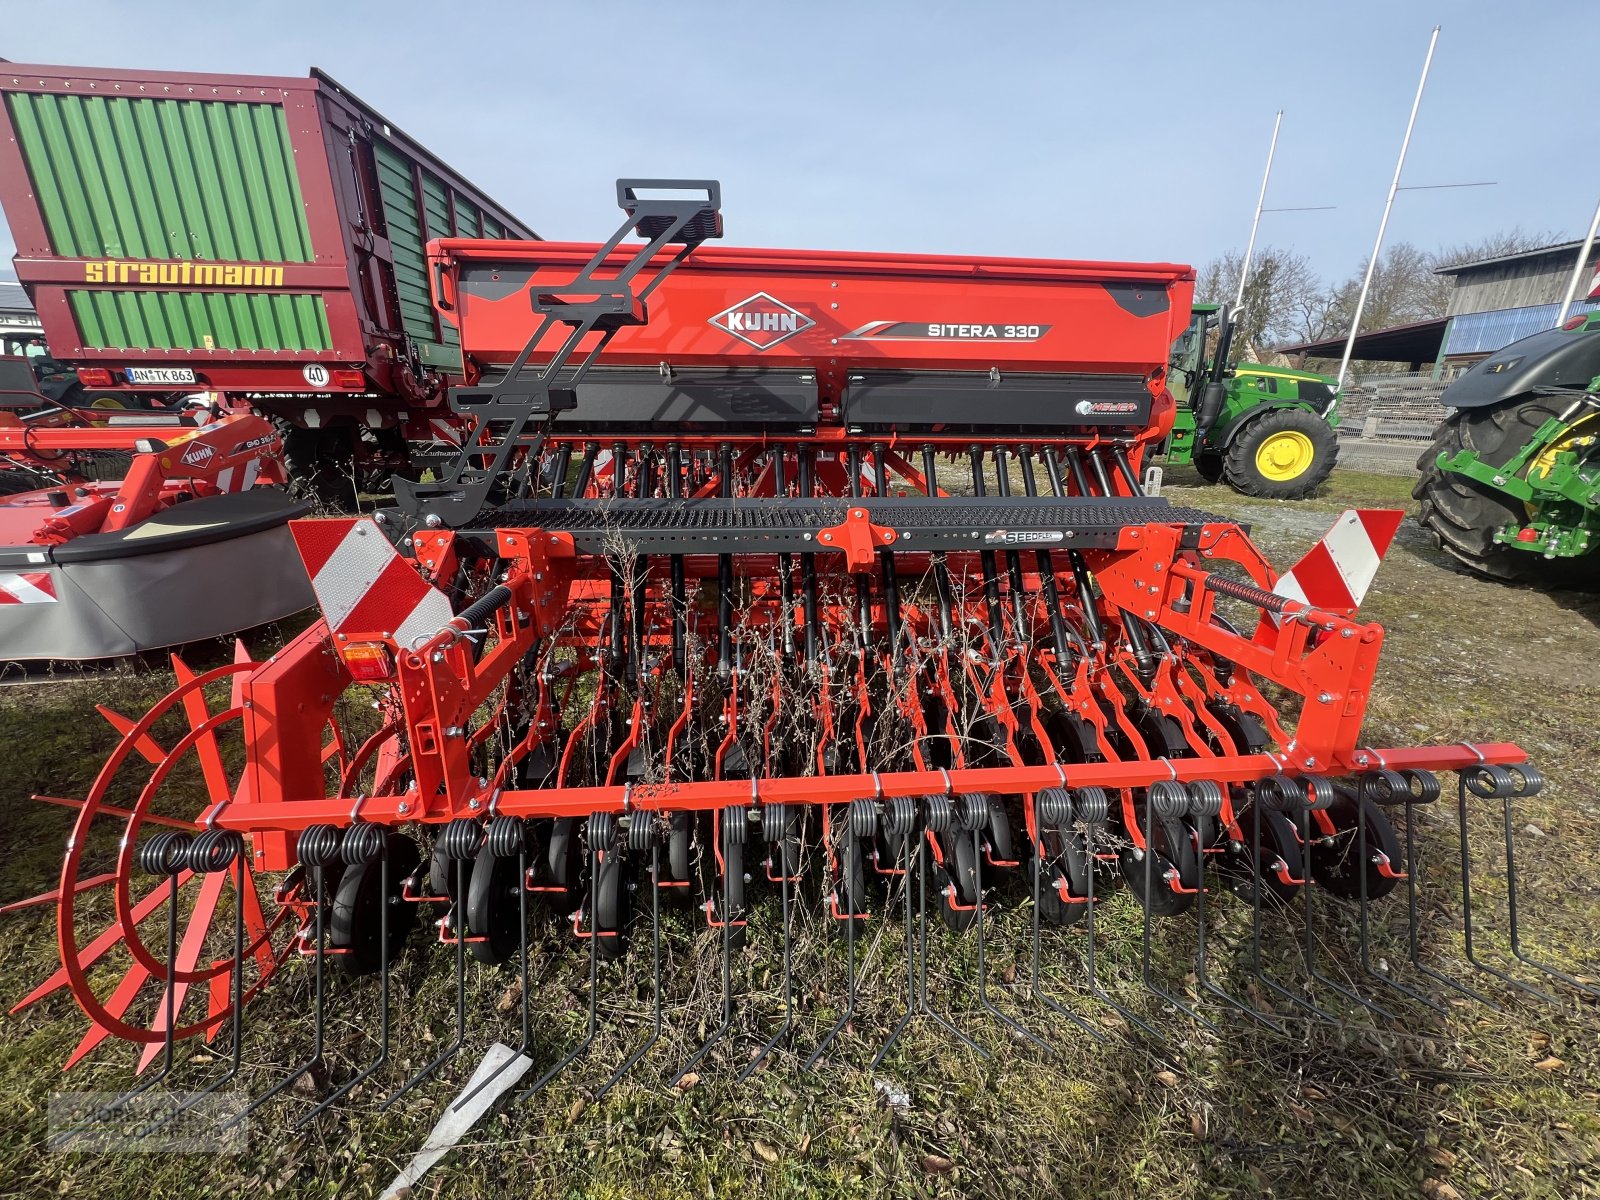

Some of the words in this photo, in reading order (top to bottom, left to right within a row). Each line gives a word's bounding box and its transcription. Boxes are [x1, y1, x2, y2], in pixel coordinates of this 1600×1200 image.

[85, 261, 284, 286] strautmann
[727, 311, 797, 333] KUHN
[927, 323, 997, 338] SITERA
[1004, 324, 1040, 338] 330
[134, 370, 149, 381] AN
[154, 370, 170, 381] TK
[171, 370, 193, 381] 863
[308, 367, 324, 383] 40
[186, 447, 213, 464] KUHN
